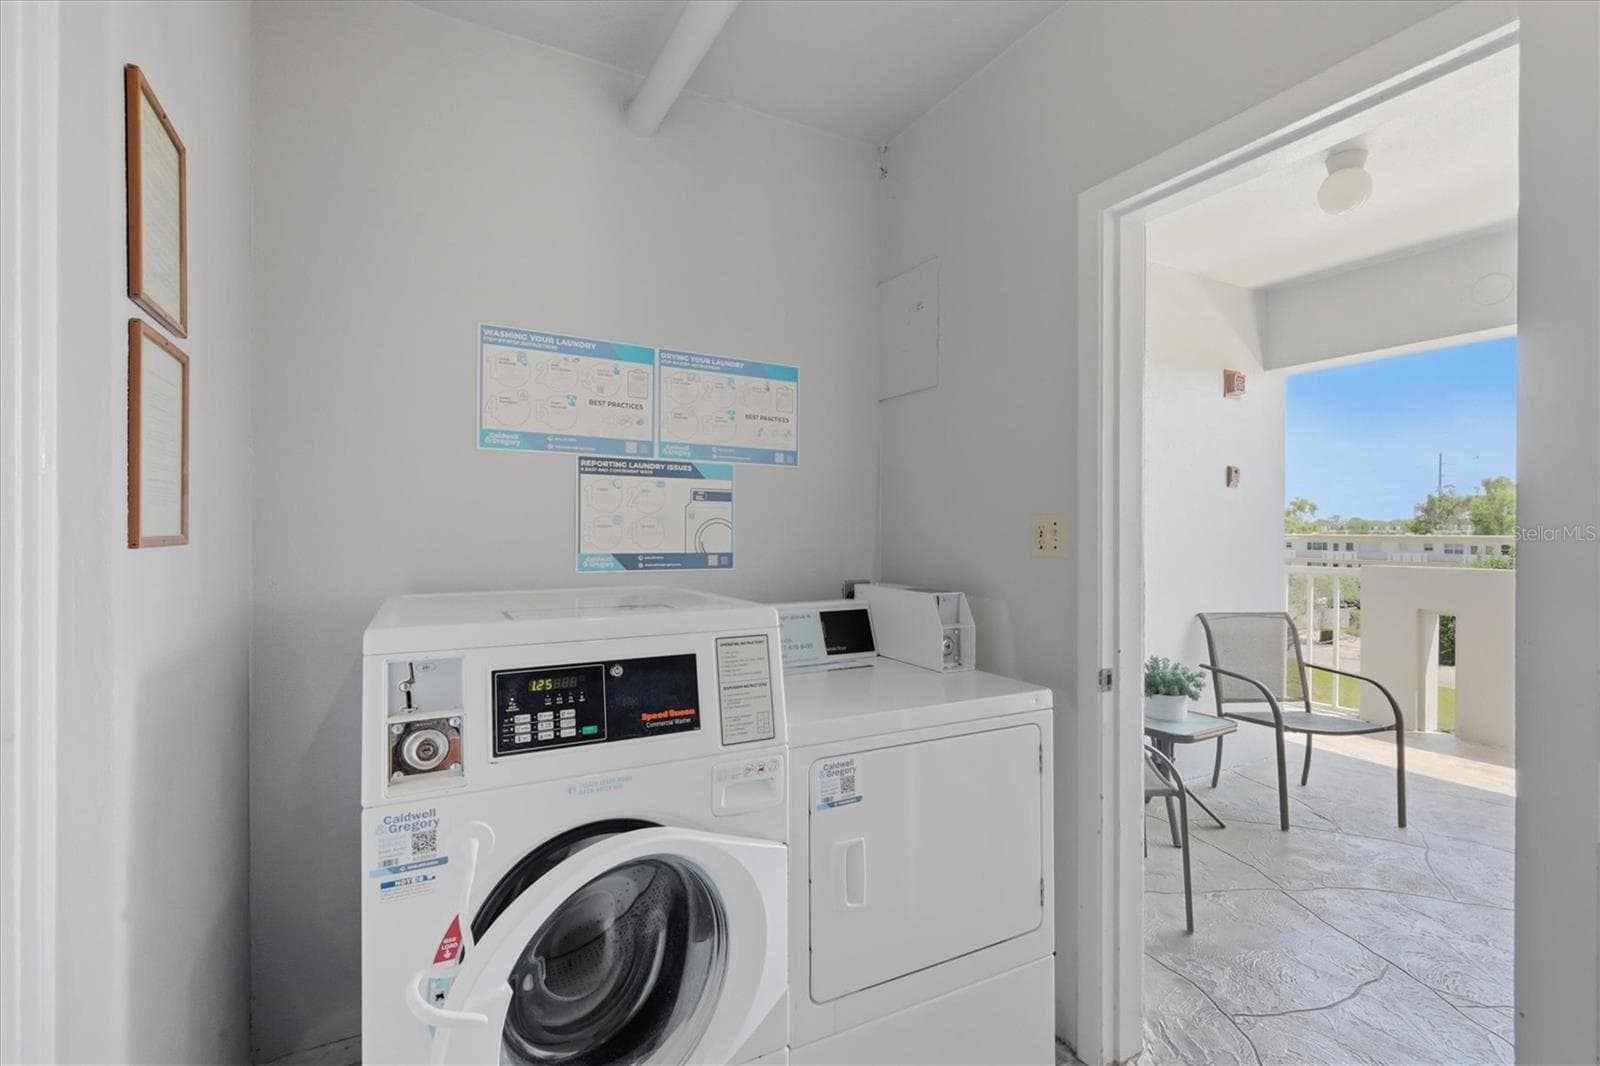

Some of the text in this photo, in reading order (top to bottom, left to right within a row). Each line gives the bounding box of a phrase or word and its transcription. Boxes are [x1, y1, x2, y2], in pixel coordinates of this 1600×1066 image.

[482, 328, 597, 350] WASHING YOUR LAUNDRY
[660, 352, 745, 369] DRYING YOUR LAUNDRY
[588, 399, 644, 410] BEST PRACTICES
[760, 415, 789, 424] PRACTICES
[580, 459, 692, 472] REPORTING LAUNDRY ISSUES
[641, 708, 696, 721] Speed Queen
[646, 720, 674, 729] Commercial
[823, 759, 855, 771] Caldwell
[826, 767, 857, 778] Gregory
[383, 808, 436, 825] Caldwell
[388, 817, 440, 834] Gregory
[443, 936, 457, 944] MAX
[441, 942, 458, 951] LOAD
